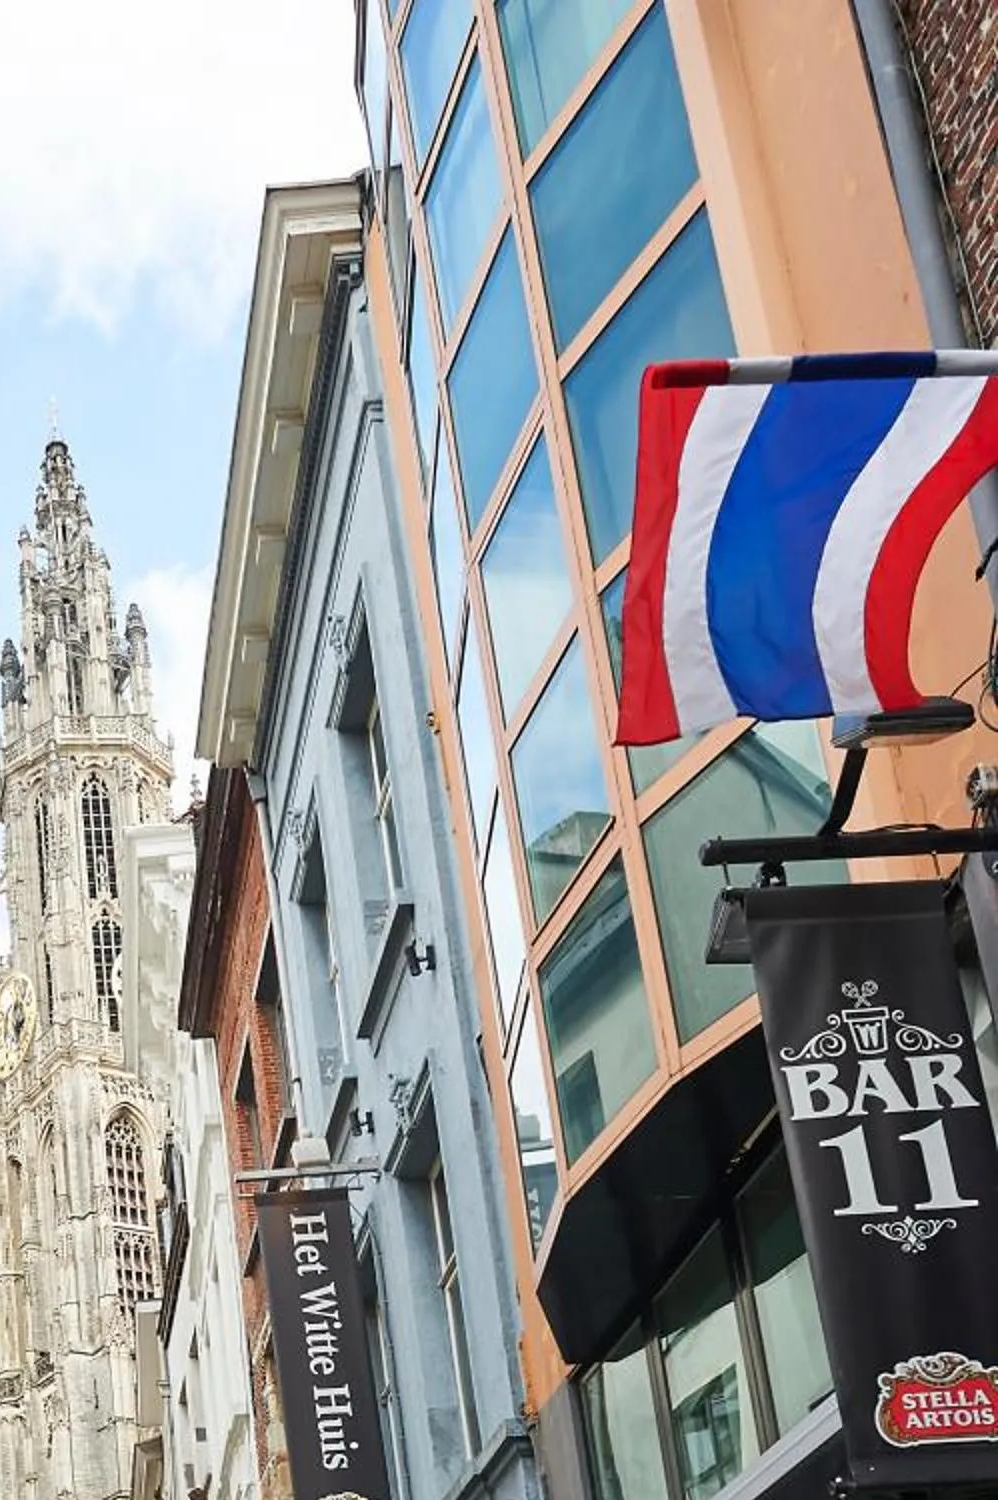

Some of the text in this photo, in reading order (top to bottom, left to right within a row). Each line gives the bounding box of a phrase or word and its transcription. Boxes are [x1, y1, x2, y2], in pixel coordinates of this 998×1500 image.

[780, 1054, 981, 1121] BAR
[818, 1118, 979, 1216] 11
[289, 1211, 359, 1470] Het Witte Huis
[901, 1389, 991, 1410] STELLA
[906, 1407, 995, 1429] ARTOIS
